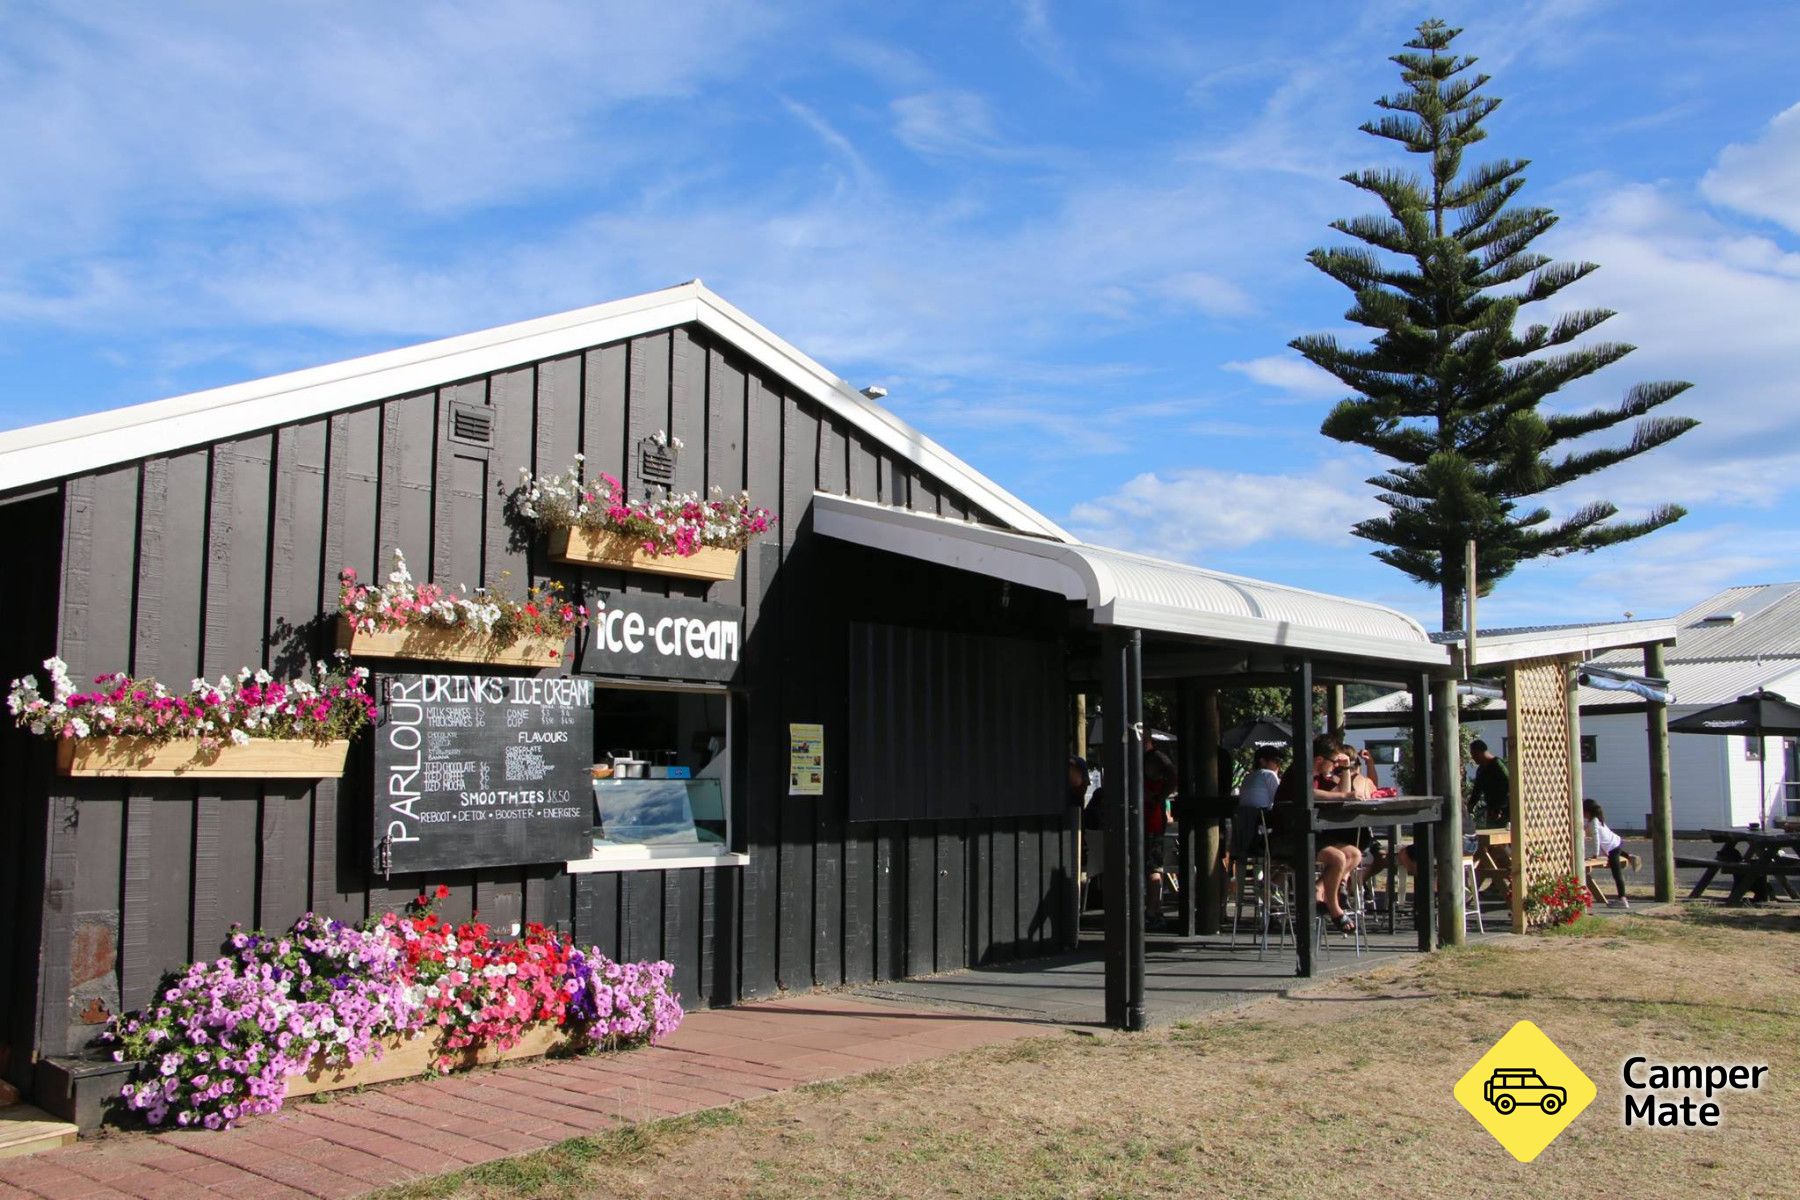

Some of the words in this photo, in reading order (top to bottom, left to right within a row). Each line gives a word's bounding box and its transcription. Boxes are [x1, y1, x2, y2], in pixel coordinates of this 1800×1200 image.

[596, 600, 738, 661] ice-cream
[422, 675, 504, 704] DRINKS
[509, 677, 543, 704] ICE
[544, 679, 589, 706] CREAM
[507, 709, 529, 719] CONE
[507, 718, 524, 728] CUP
[518, 731, 568, 743] FLAVOURS
[387, 680, 423, 842] PARLOUR
[442, 779, 466, 791] MOCHA
[460, 790, 544, 806] SMOOTHIES
[420, 811, 452, 823] REBOOT
[458, 810, 486, 822] DETOX
[495, 808, 535, 820] BOOSTER
[543, 807, 581, 818] ENERGISE
